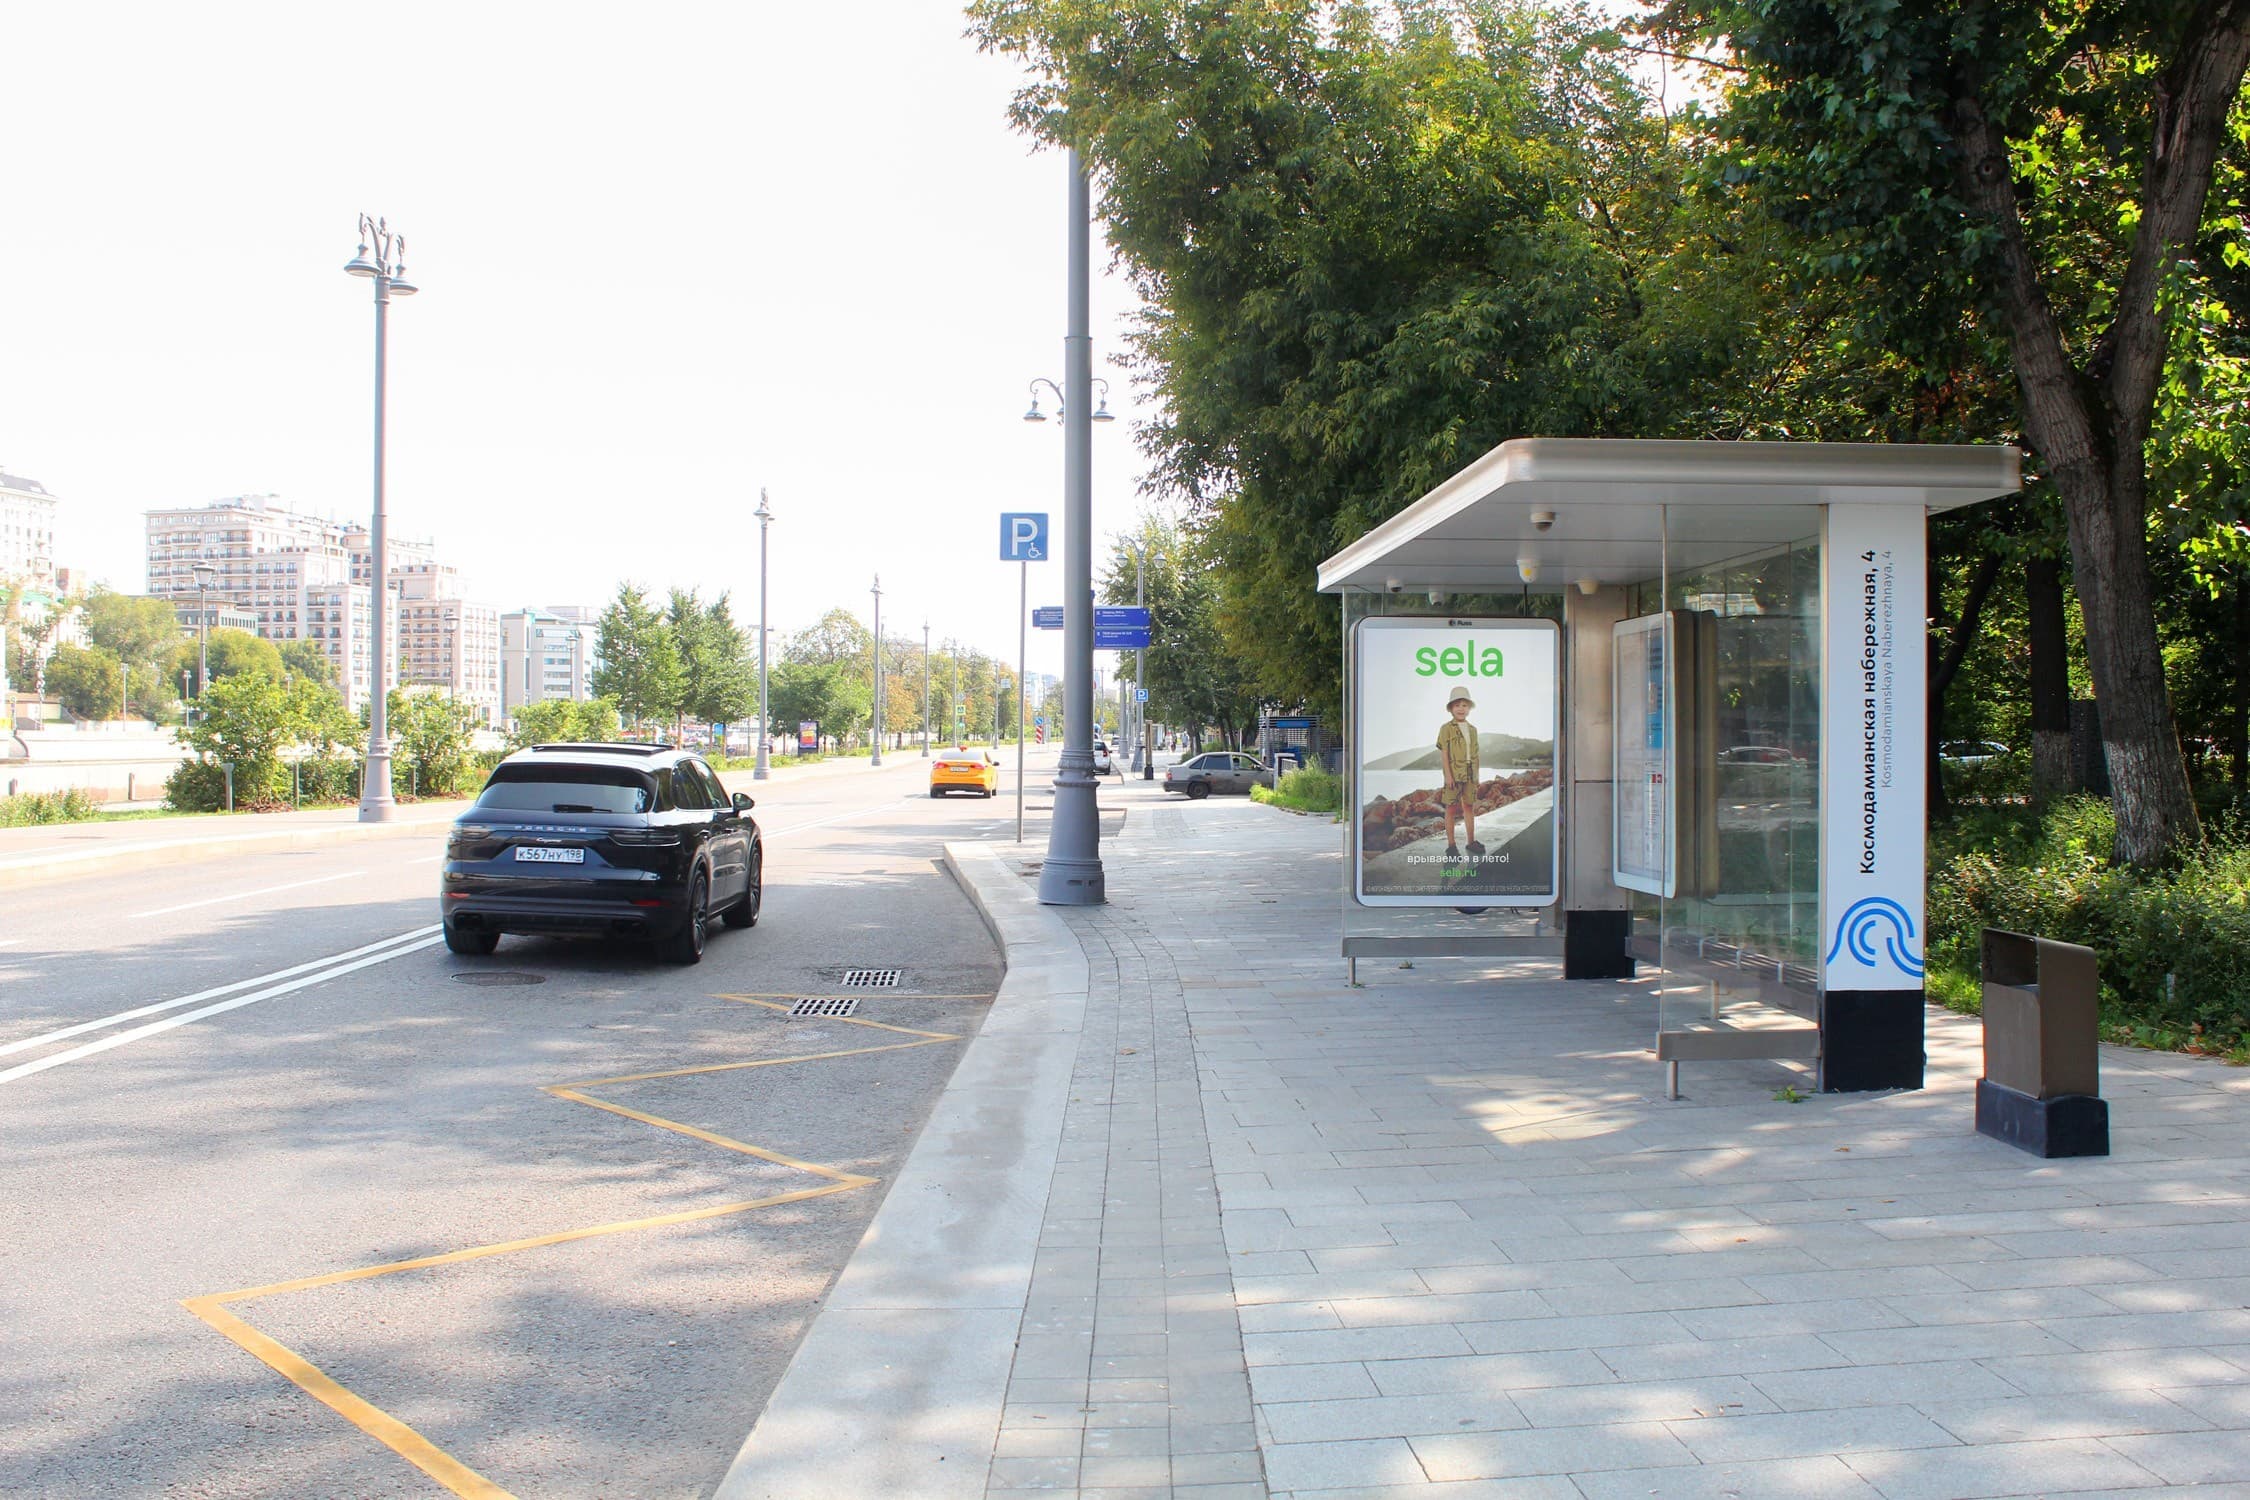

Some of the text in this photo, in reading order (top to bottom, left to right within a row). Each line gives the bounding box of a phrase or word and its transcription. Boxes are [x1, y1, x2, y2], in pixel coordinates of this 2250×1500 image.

[1011, 518, 1038, 556] P
[1415, 639, 1504, 677] sela
[1881, 550, 1894, 788] Kosmodamianskaya Naberezhnaya, 4
[1860, 550, 1879, 874] Космодамианская набережная, 4
[1440, 867, 1477, 877] sela.ru
[1472, 855, 1479, 863] в
[1481, 852, 1510, 863] лето!
